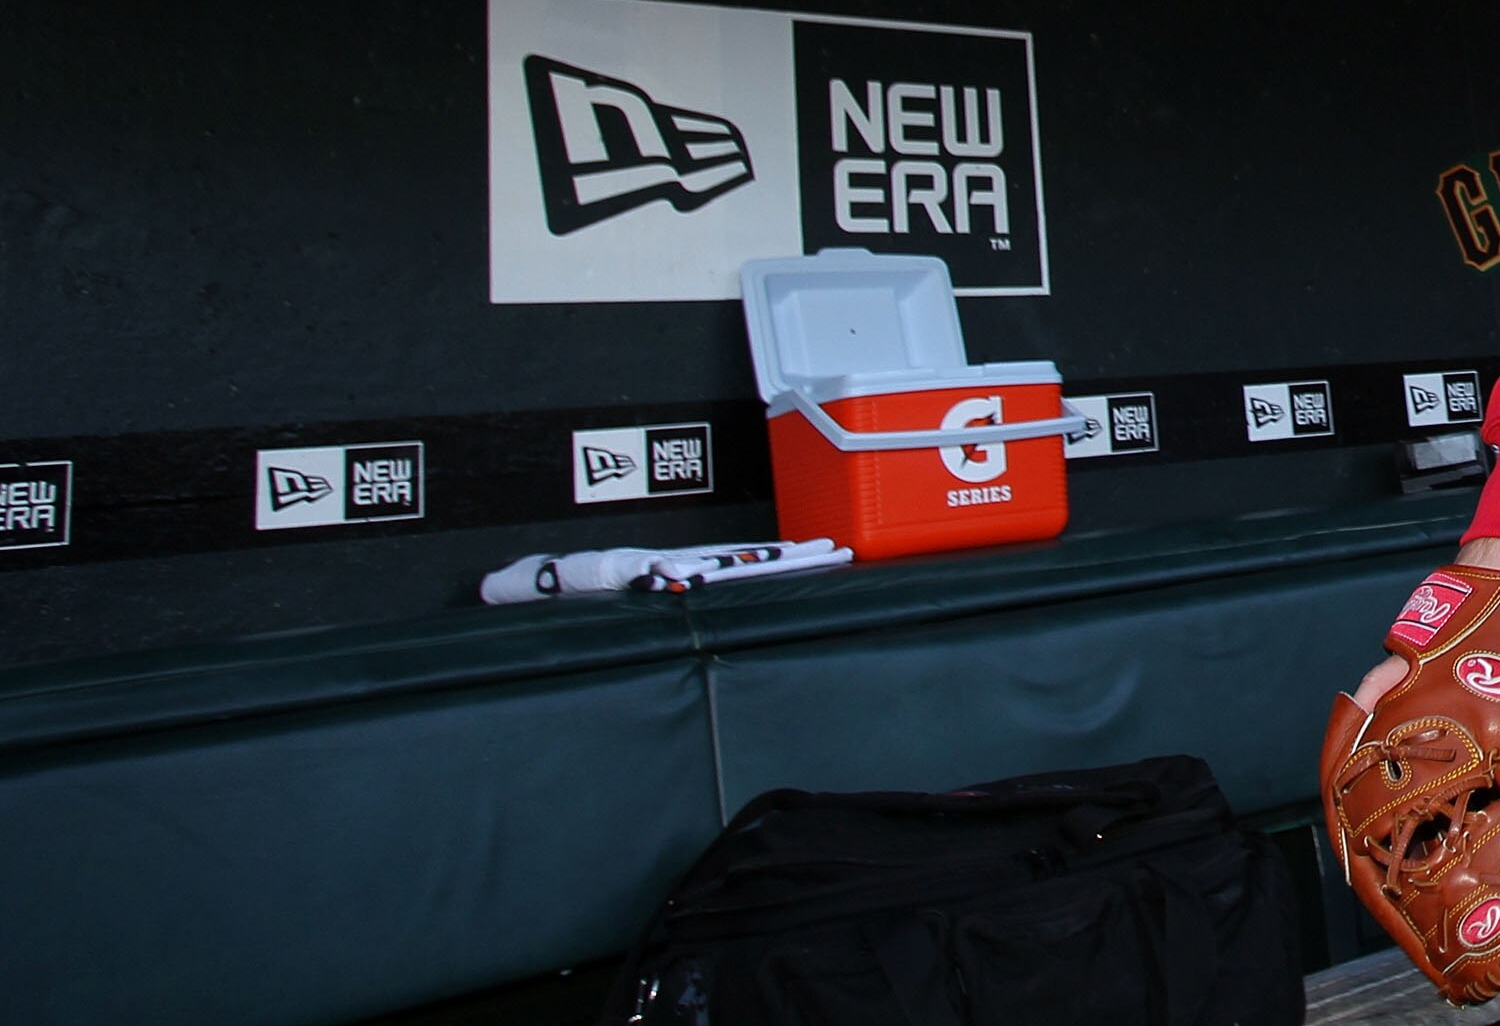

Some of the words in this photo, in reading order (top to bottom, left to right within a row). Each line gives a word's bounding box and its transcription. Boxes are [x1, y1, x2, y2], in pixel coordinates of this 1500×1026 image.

[829, 79, 1004, 157] NEW
[833, 159, 1010, 234] ERA
[1293, 393, 1325, 410] NEW
[1447, 382, 1475, 399] NEW
[1112, 405, 1148, 424] NEW
[1450, 397, 1477, 413] ERA
[1296, 409, 1327, 425] ERA
[938, 395, 1007, 483] G
[1114, 423, 1150, 441] ERA
[653, 438, 702, 461] NEW
[353, 459, 412, 483] NEW
[654, 459, 703, 481] ERA
[354, 481, 412, 505] ERA
[947, 485, 1012, 507] SERIES
